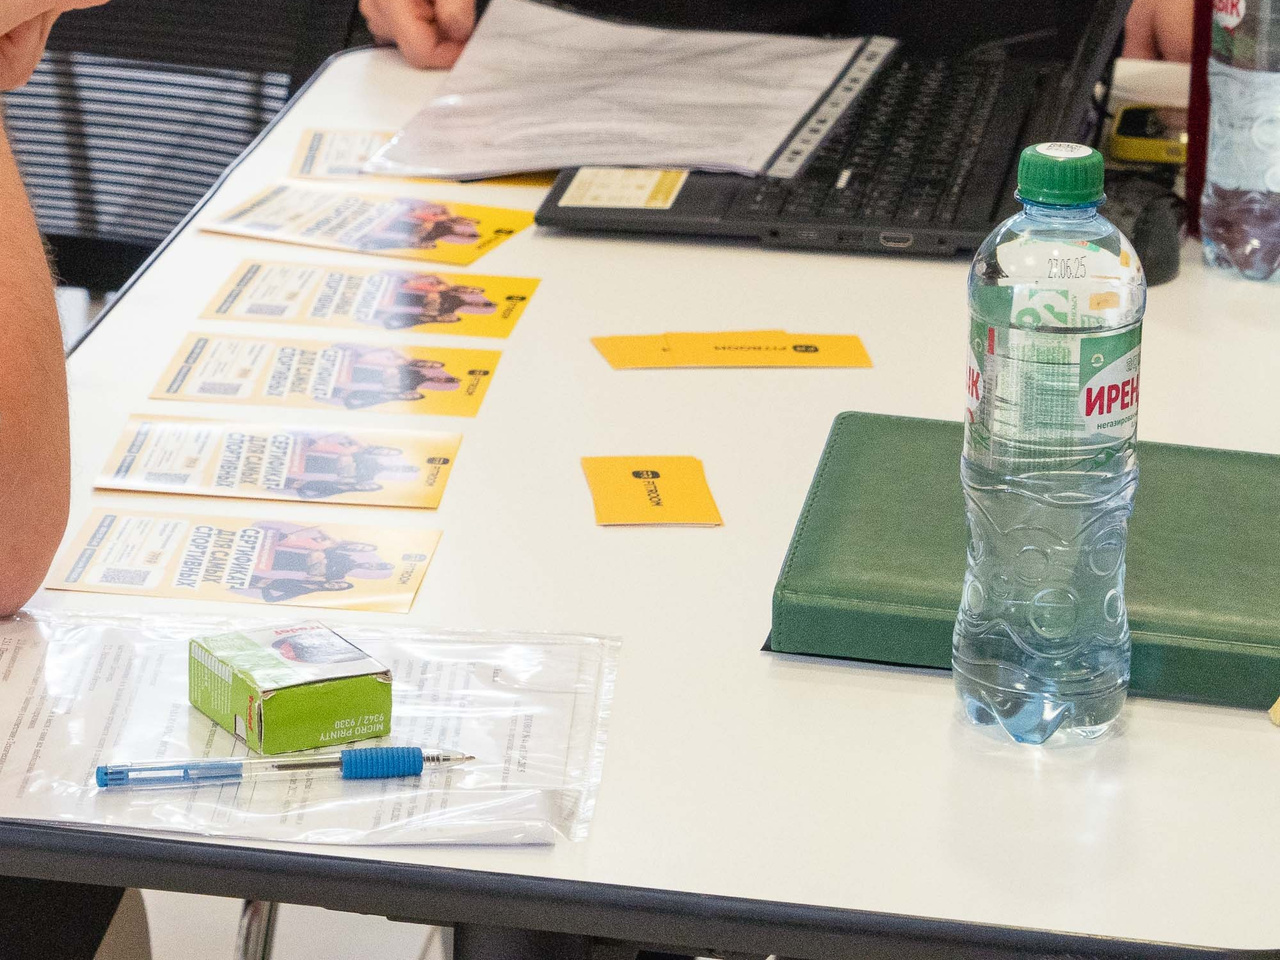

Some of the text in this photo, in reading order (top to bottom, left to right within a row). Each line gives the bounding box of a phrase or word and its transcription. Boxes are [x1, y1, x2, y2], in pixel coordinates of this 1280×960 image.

[1048, 256, 1087, 279] 27.06.25
[214, 433, 245, 488] СПОРТИВНЫХ
[239, 436, 267, 485] ДЛЯ САМЫХ
[264, 435, 290, 486] СЕРТИФИКАТ
[645, 480, 663, 507] FITROOM
[175, 526, 211, 588] СПОРТИВНЫХ
[201, 529, 235, 583] ДЛЯ САМЫХ
[227, 529, 260, 586] СЕРТИФИКАТ
[320, 724, 384, 741] MICRO PRINTY
[335, 719, 355, 728] 9330
[364, 714, 384, 724] 9342
